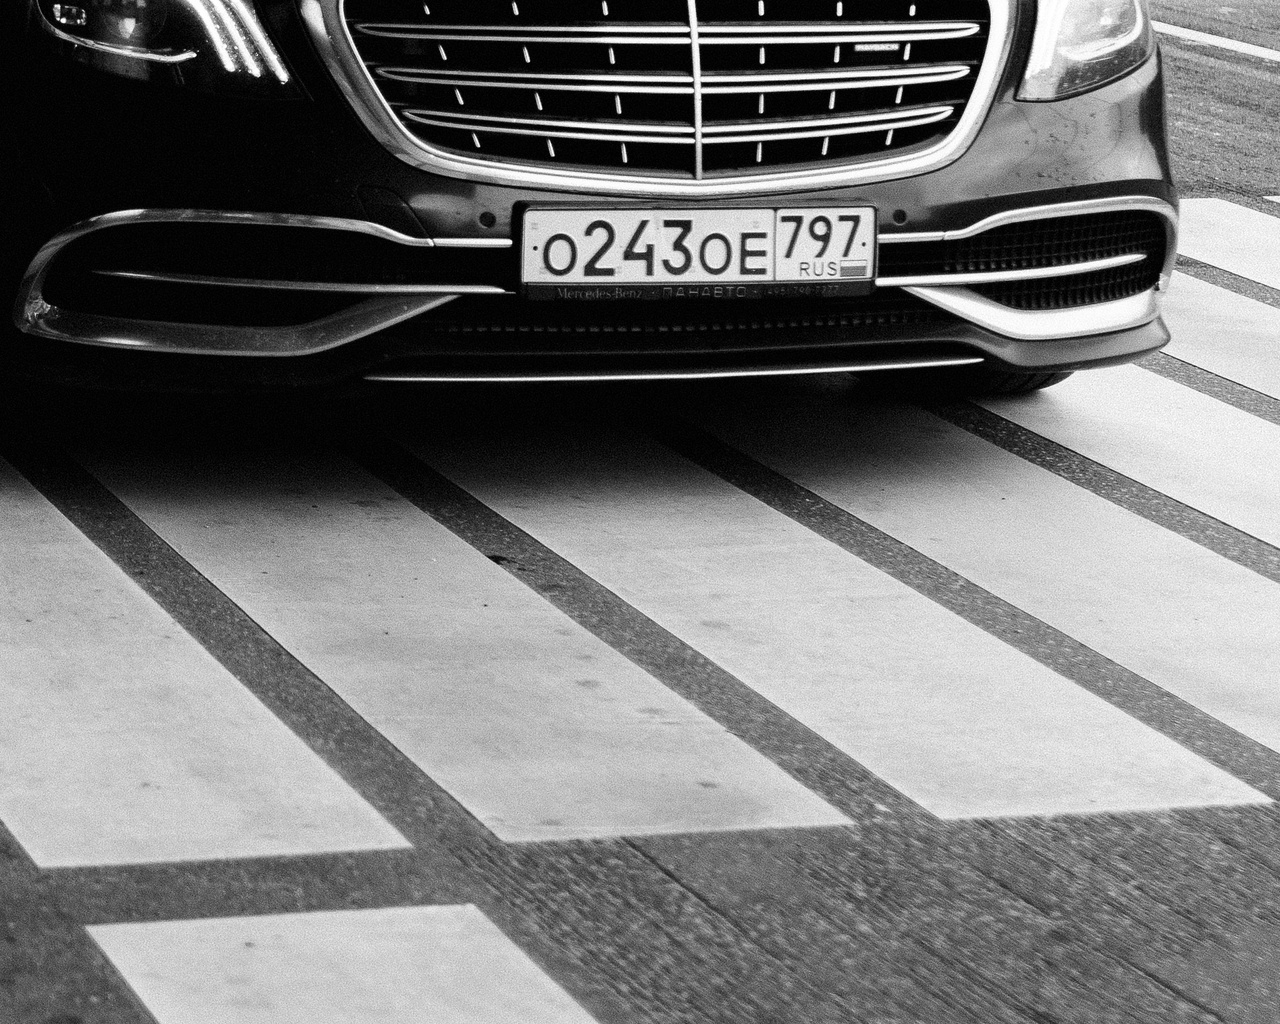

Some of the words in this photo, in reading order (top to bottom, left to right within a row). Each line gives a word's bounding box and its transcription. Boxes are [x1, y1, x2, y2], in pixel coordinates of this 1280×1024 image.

[780, 214, 862, 260] 797
[799, 261, 838, 277] RUS
[662, 286, 747, 298] ПАНАВТО
